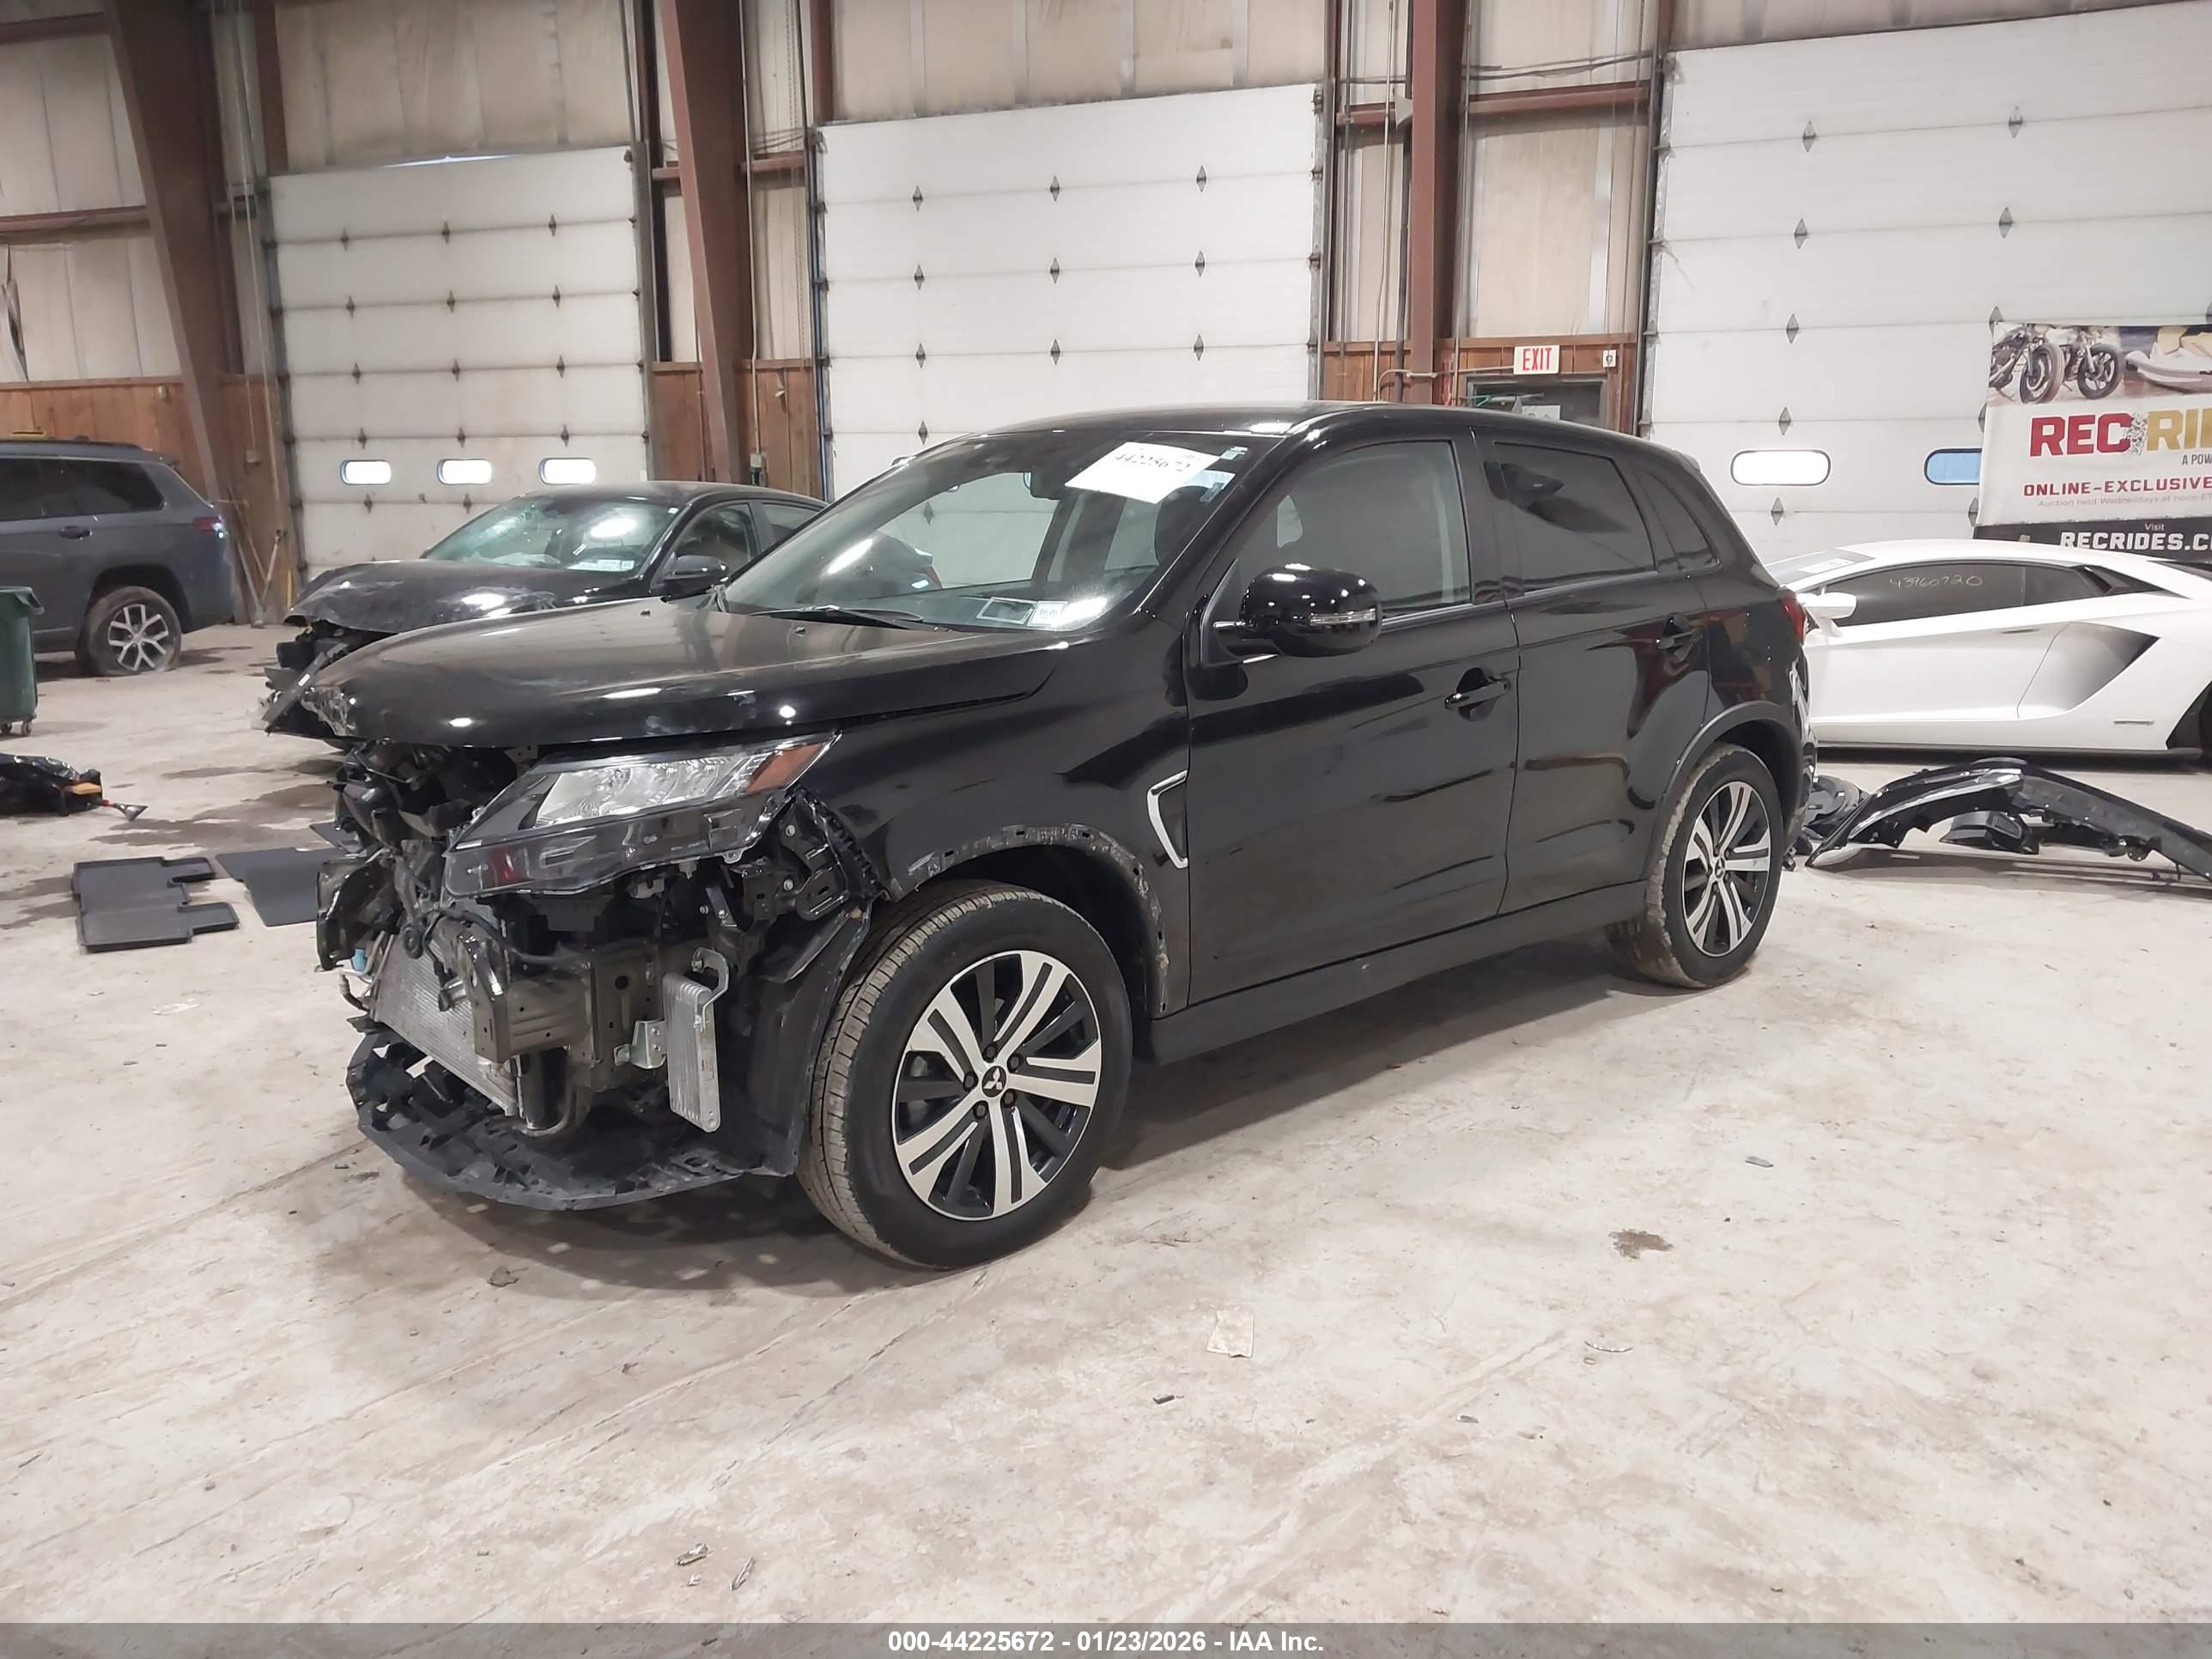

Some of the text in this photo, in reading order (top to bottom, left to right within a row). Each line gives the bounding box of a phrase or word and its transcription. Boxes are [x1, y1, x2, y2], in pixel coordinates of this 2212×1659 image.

[1522, 348, 1553, 371] EXIT
[2029, 412, 2134, 457] REC
[2182, 454, 2189, 465] A
[2024, 477, 2212, 496] ONLINE-EXCLUSIVE
[2039, 499, 2075, 507] Auction
[2077, 497, 2097, 506] held
[2100, 495, 2158, 506] Wednesdays
[2060, 532, 2212, 550] RECRIDES.C
